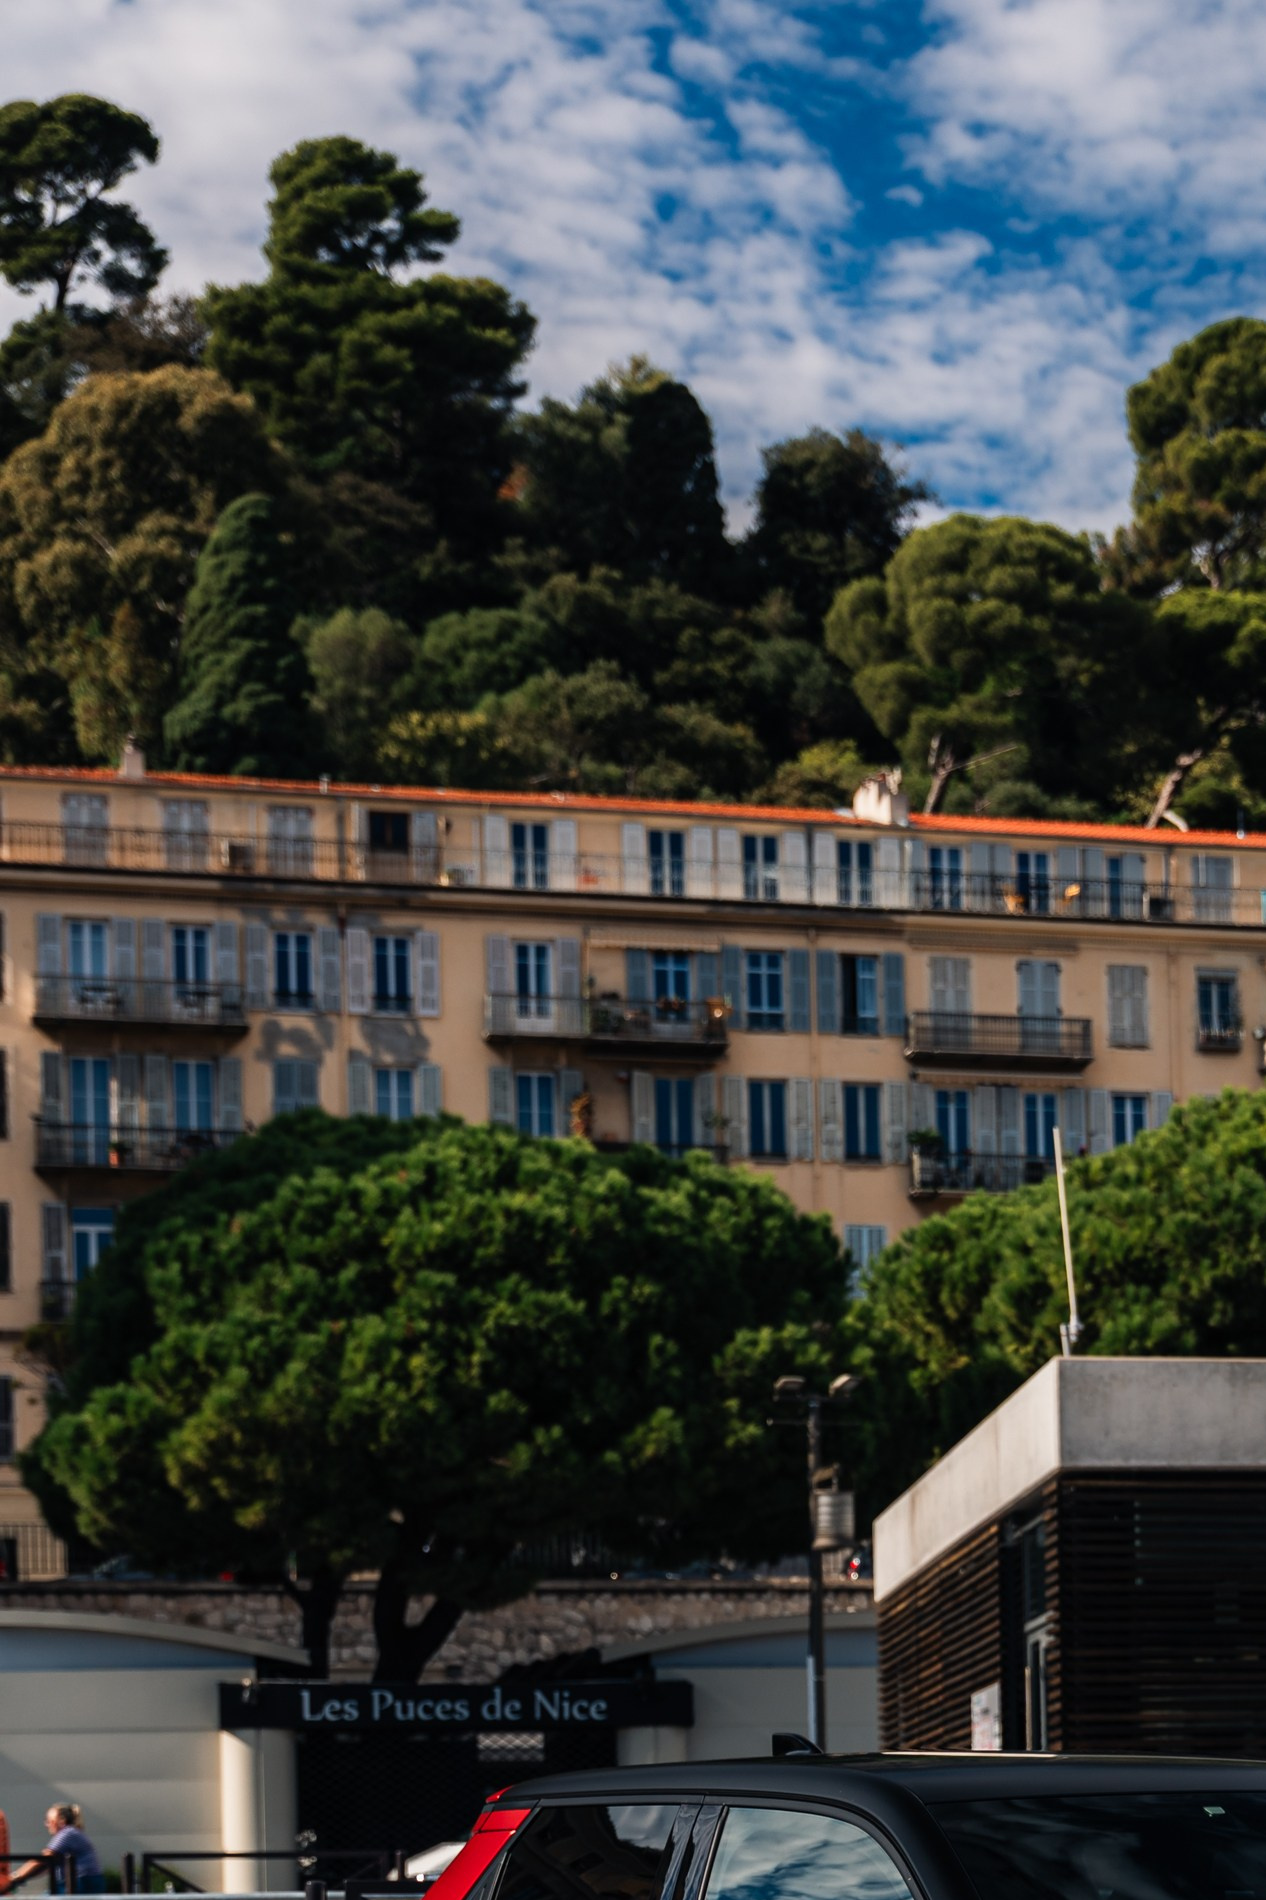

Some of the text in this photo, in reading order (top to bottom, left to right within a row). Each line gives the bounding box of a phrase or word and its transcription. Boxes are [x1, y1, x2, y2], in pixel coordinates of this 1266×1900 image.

[300, 1686, 608, 1722] Les Puces de Nice
